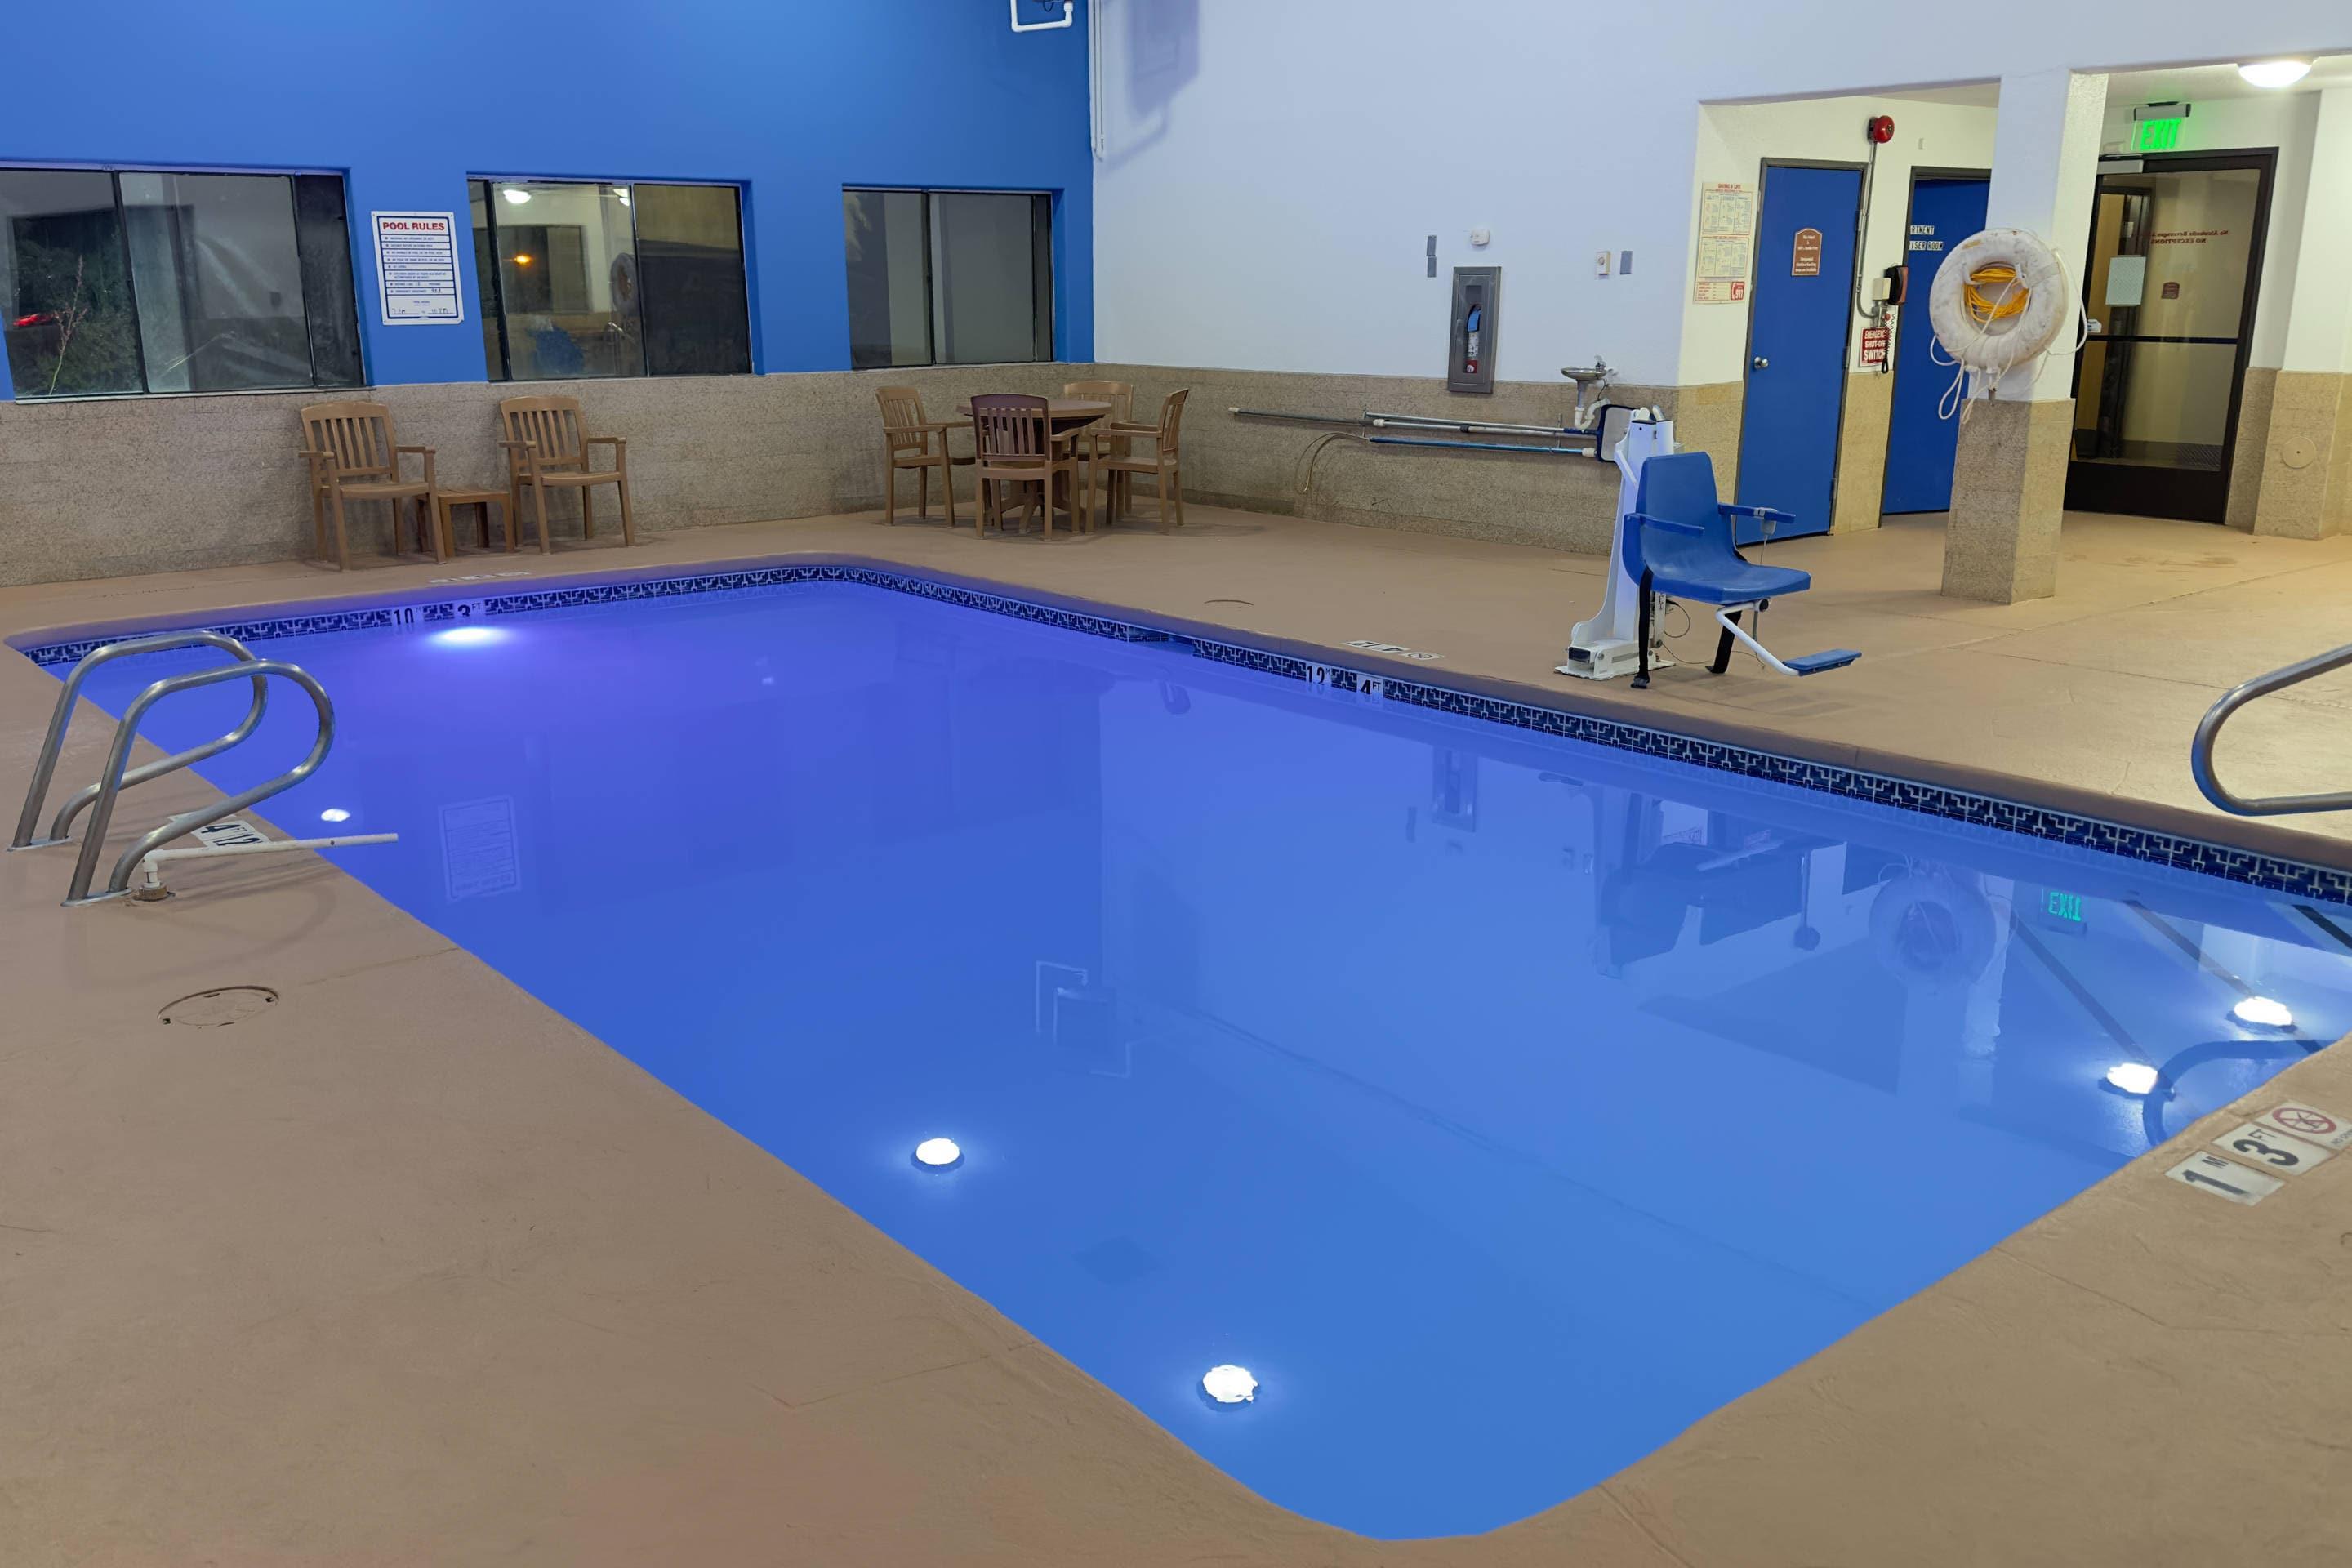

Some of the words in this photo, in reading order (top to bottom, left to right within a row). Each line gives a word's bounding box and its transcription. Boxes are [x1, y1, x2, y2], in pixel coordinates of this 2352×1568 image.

[2140, 118, 2182, 150] EXIT
[382, 221, 410, 230] POOL
[412, 222, 445, 231] RULES
[1927, 241, 1943, 250] ROOM
[1372, 680, 1381, 691] FT
[2232, 1138, 2300, 1166] 3
[2181, 1169, 2251, 1196] 1
